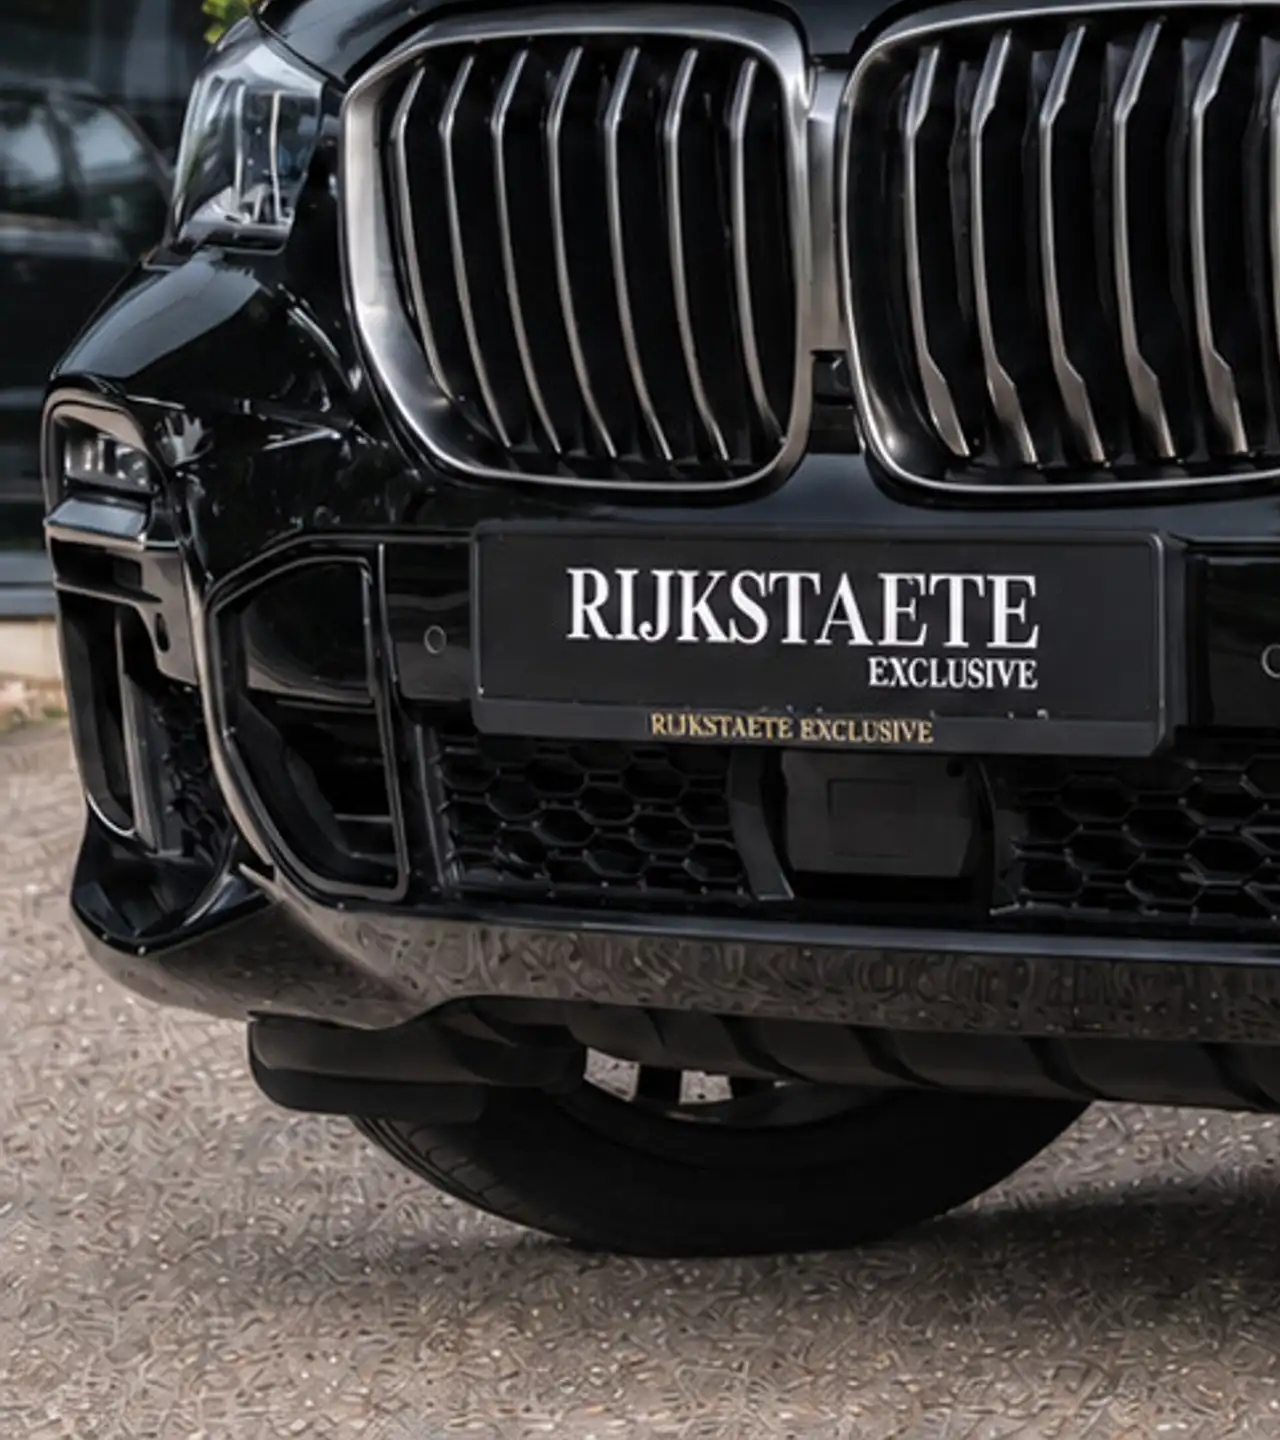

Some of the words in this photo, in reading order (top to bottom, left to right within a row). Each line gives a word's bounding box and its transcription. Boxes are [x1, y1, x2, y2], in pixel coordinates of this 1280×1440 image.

[566, 567, 1040, 650] RIJKSTAETE
[868, 656, 1039, 691] EXCLUSIVE
[650, 712, 794, 740] RIJKSTAETE
[799, 717, 934, 744] EXCLUSIVE
